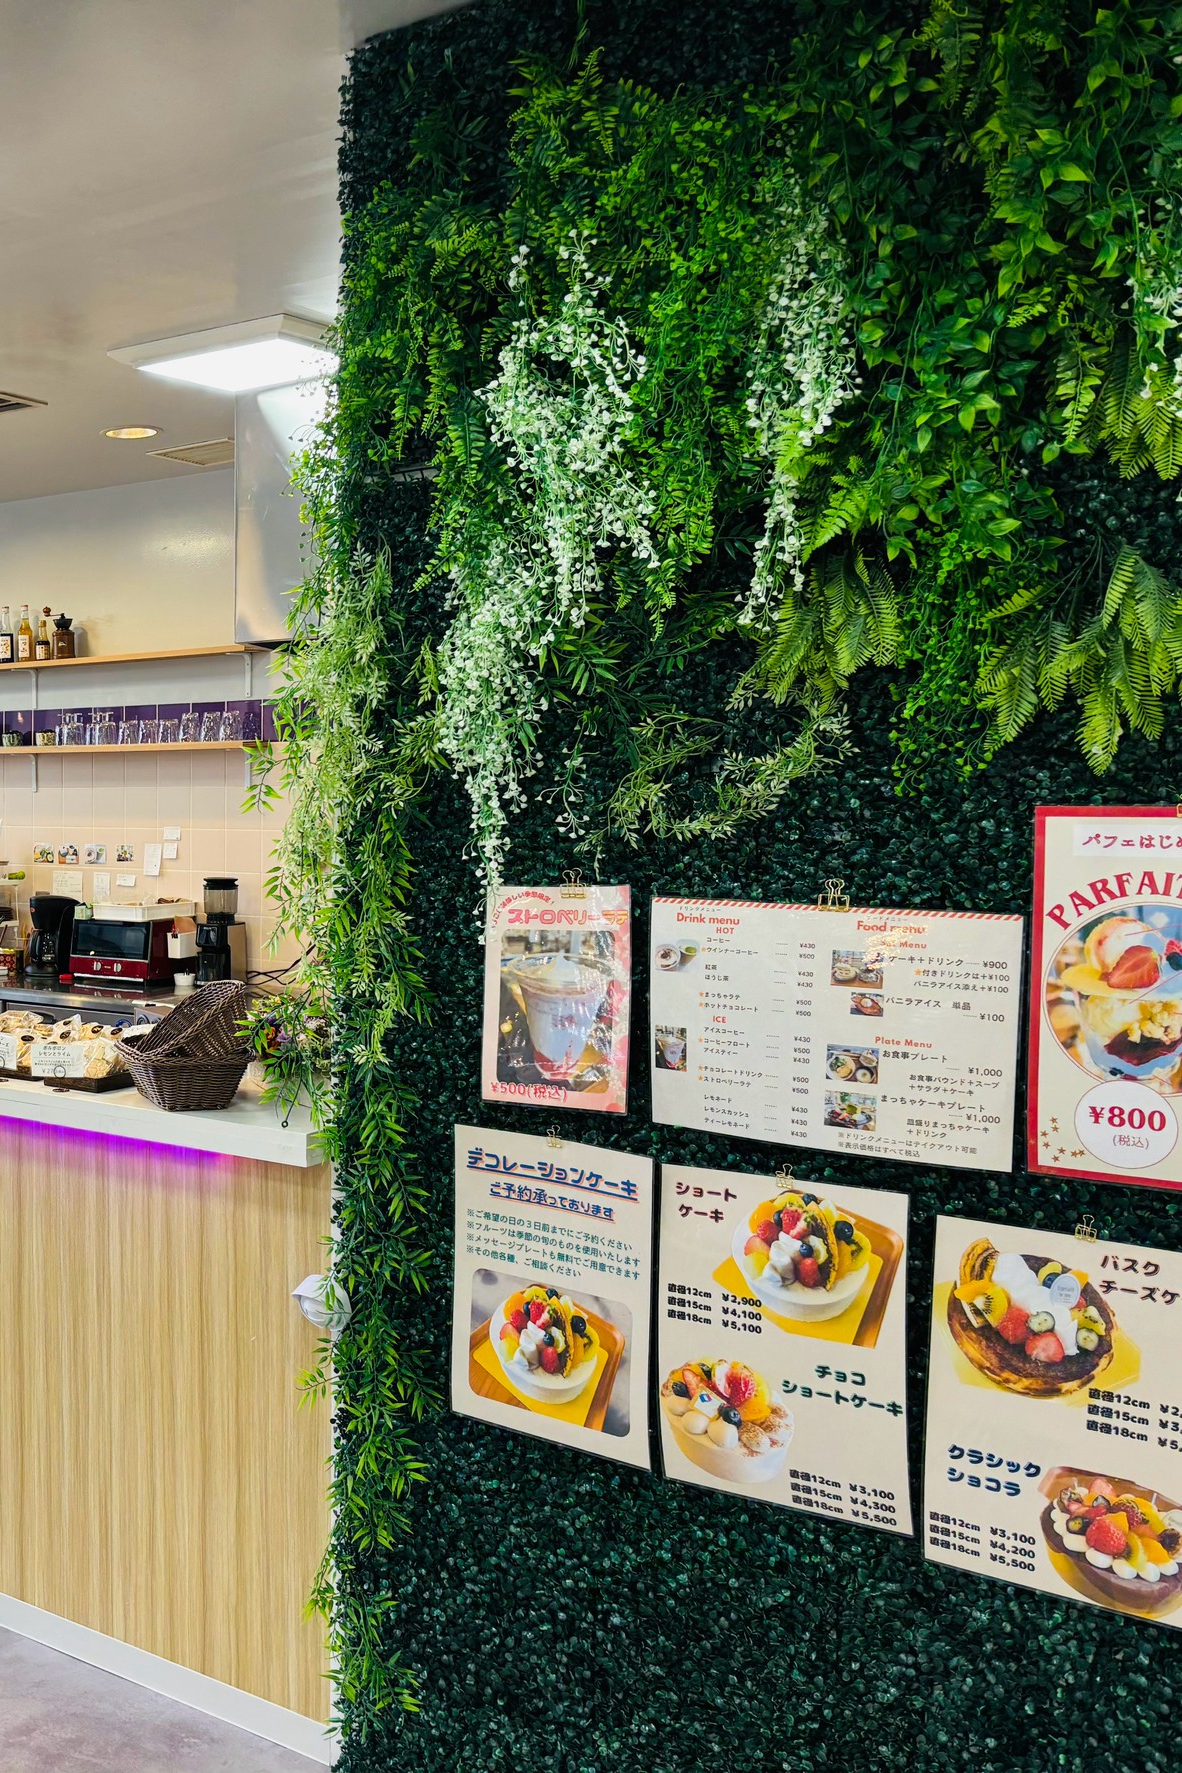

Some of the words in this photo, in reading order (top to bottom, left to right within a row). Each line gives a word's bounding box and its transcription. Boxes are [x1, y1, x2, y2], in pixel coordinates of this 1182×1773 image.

[508, 909, 628, 925] ストロベリーラテ
[676, 913, 705, 923] Drink
[709, 916, 740, 925] menu
[857, 921, 887, 932] Food
[899, 940, 927, 949] Menu
[983, 961, 1007, 969] ¥900
[704, 1002, 759, 1012] ホットチョコレート
[886, 997, 941, 1008] バニラアイス
[952, 1002, 971, 1010] 単品
[979, 1013, 1005, 1022] ¥100
[704, 1027, 745, 1035] アイスコーヒー
[704, 1038, 750, 1048] コーヒーフロート
[704, 1047, 738, 1055] アイスティー
[875, 1036, 901, 1046] Plate
[905, 1039, 932, 1048] Menu
[882, 1050, 948, 1063] お食事プレート
[704, 1065, 763, 1078] チョコレートドリンク
[968, 1067, 1002, 1077] ¥1,000
[491, 1082, 567, 1102] ¥500(税込)
[704, 1094, 732, 1103] レモネード
[791, 1106, 808, 1114] ¥430
[704, 1106, 749, 1117] レモンスカッシュ
[881, 1095, 985, 1112] まっちゃケーキプレート
[966, 1114, 1000, 1123] ¥1,000
[1089, 1106, 1166, 1132] ¥800
[1113, 1135, 1149, 1149] (税込)
[467, 1148, 638, 1196] デコレーションケーキ
[490, 1182, 614, 1219] ご予約承っております
[676, 1182, 737, 1202] ショート
[679, 1204, 724, 1223] ケーキ
[1100, 1255, 1160, 1276] バスク
[668, 1283, 712, 1298] 直径12cm
[722, 1293, 762, 1308] ¥2,900
[668, 1296, 712, 1312] 直径15cm
[722, 1306, 762, 1321] ¥4,100
[668, 1309, 712, 1325] 直径18cm
[722, 1319, 762, 1334] ¥5,100
[814, 1365, 866, 1386] チョコ
[782, 1379, 903, 1417] ショートケーキ
[1088, 1387, 1151, 1410] 直径12cm
[1087, 1404, 1149, 1426] 直径15cm
[1086, 1419, 1148, 1442] 直径18cm
[948, 1444, 1041, 1477] クラシック
[789, 1469, 841, 1488] 直径12cm
[849, 1483, 895, 1500] ¥3,100
[947, 1467, 1021, 1497] ショコラ
[790, 1482, 842, 1501] 直径15cm
[850, 1496, 896, 1513] ¥4,300
[792, 1495, 844, 1514] 直径18cm
[851, 1509, 897, 1526] ¥5,500
[930, 1511, 981, 1531] 直径12cm
[990, 1526, 1036, 1545] ¥3,100
[930, 1524, 980, 1544] 直径15cm
[989, 1539, 1035, 1558] ¥4,200
[930, 1536, 980, 1557] 直径18cm
[989, 1552, 1035, 1571] ¥5,500
